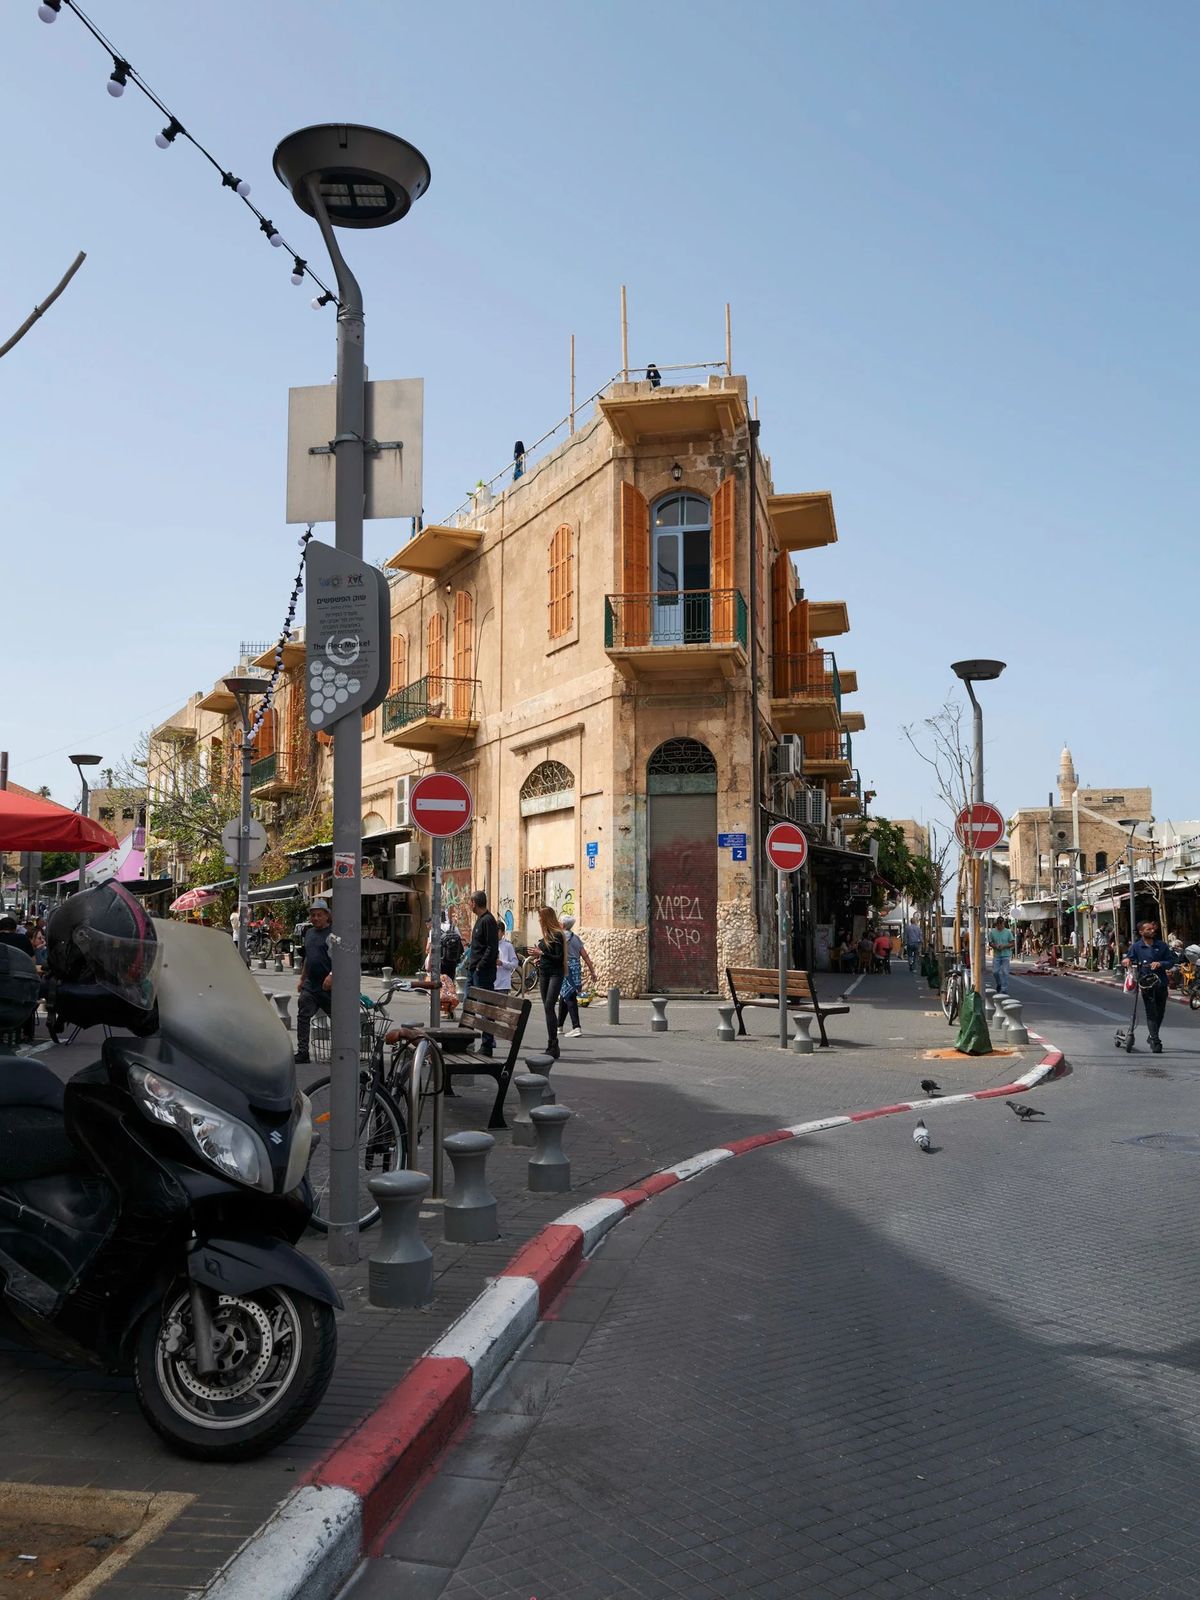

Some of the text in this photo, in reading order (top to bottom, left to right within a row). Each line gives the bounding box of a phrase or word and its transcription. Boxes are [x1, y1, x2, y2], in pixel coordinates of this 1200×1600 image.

[316, 594, 367, 605] שוק הפשפשים
[327, 642, 343, 650] Flea
[344, 640, 370, 648] Market
[736, 850, 743, 858] 2
[665, 925, 701, 949] КРЮ
